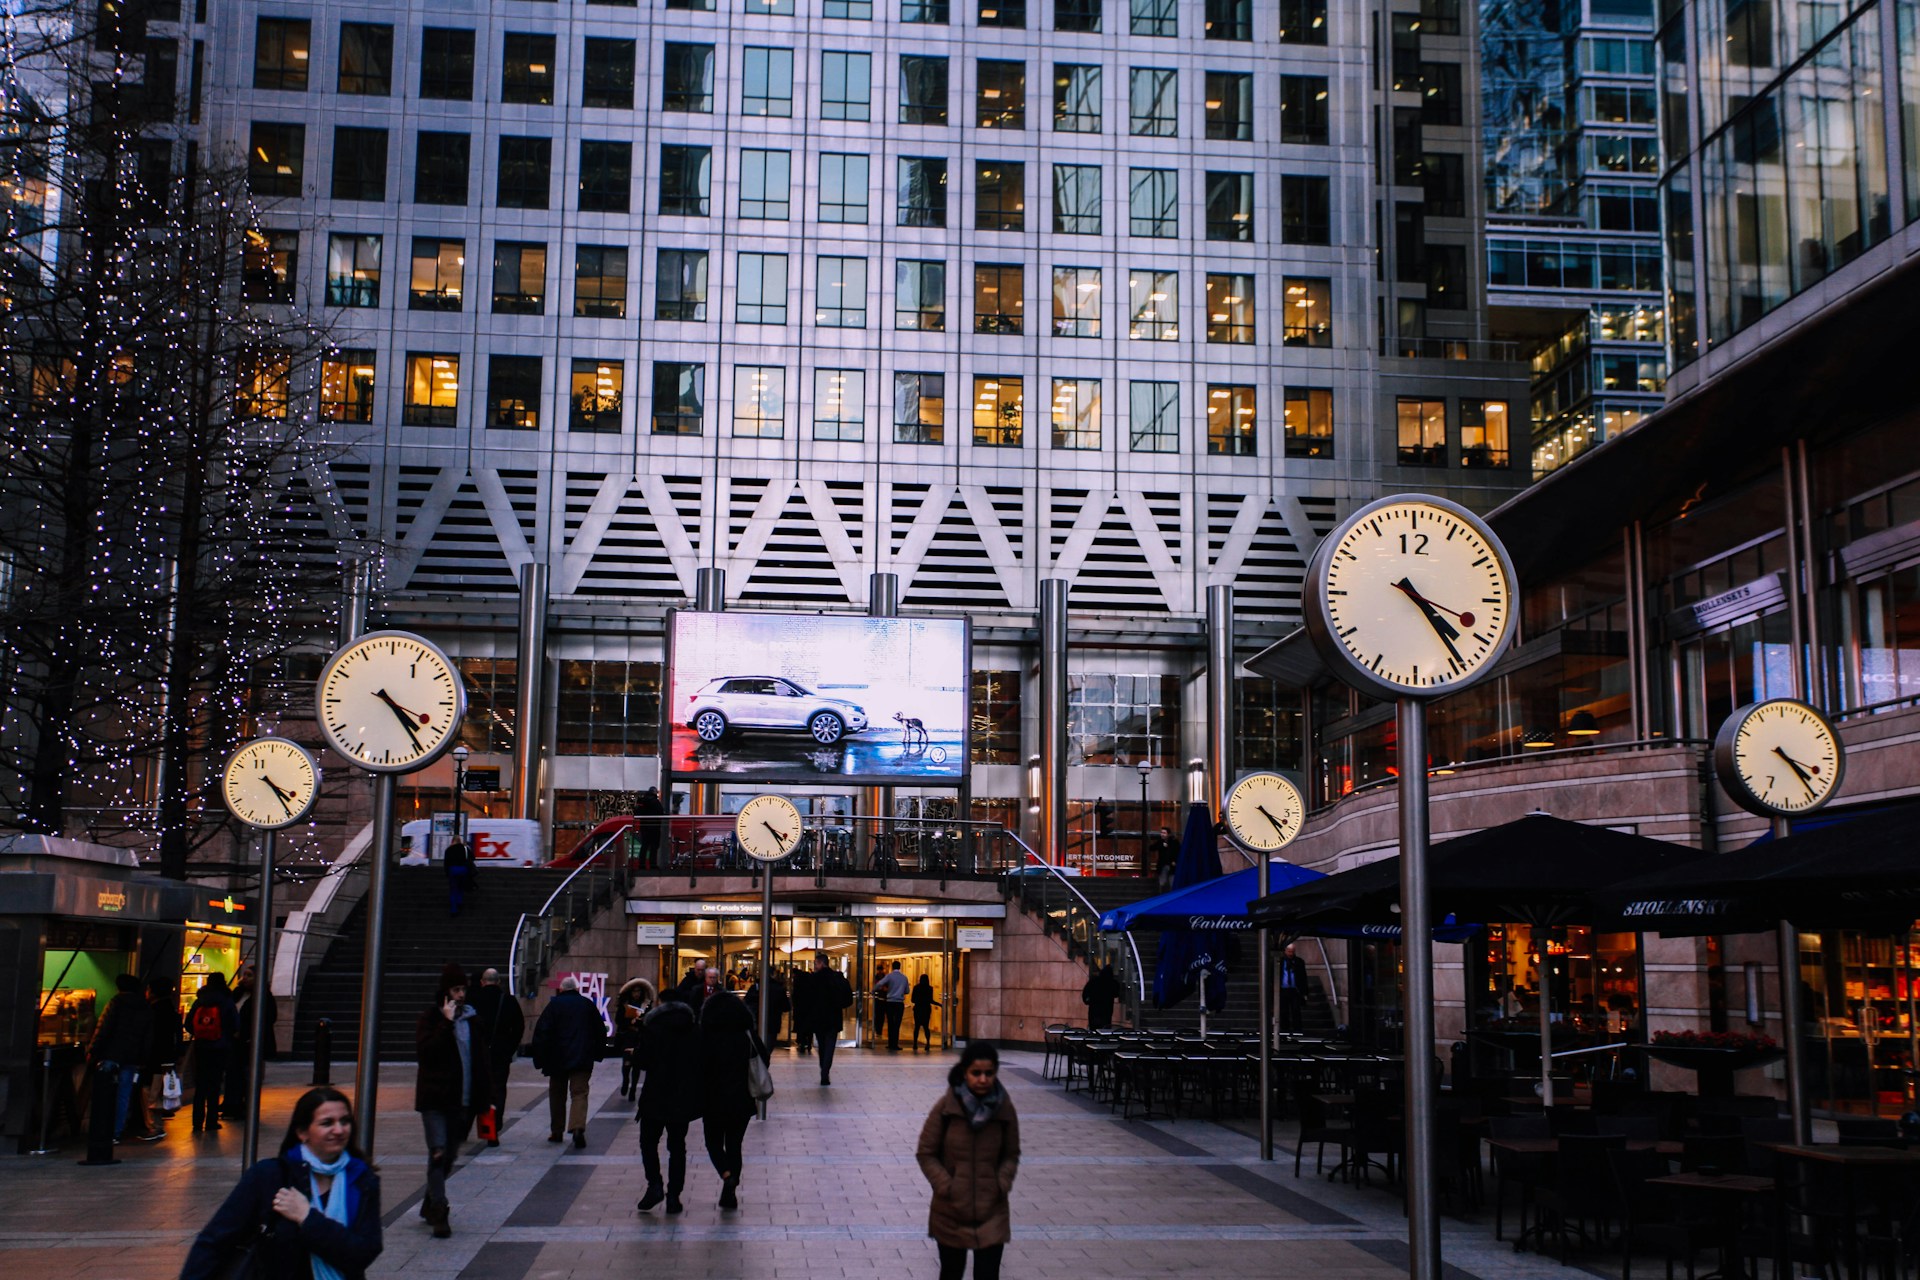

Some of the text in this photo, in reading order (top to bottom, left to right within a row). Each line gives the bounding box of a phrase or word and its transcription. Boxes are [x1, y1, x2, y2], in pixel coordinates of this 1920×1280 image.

[1399, 533, 1429, 556] 12
[410, 663, 416, 678] 1
[253, 759, 265, 769] 11
[1766, 775, 1775, 789] 7
[1284, 808, 1290, 818] 3
[716, 904, 740, 912] Canada
[740, 905, 762, 914] Square
[876, 906, 906, 915] Shopping
